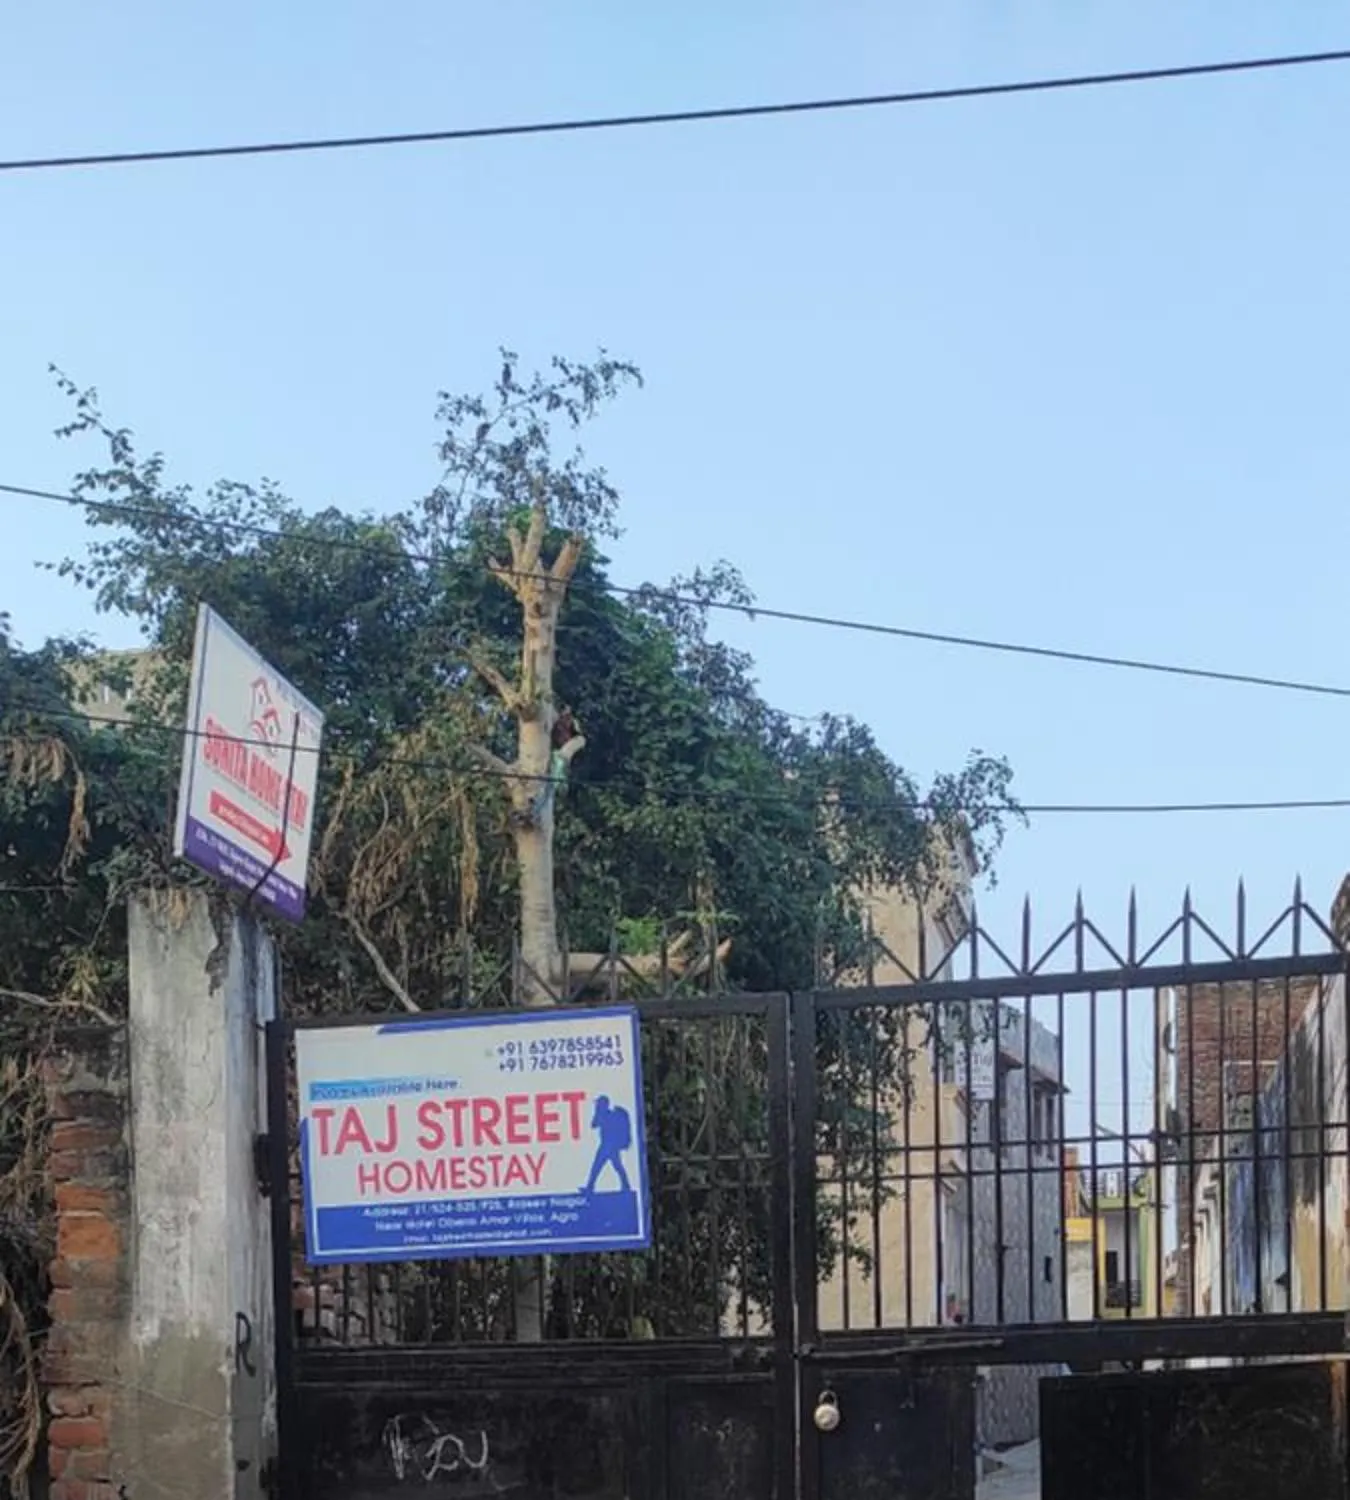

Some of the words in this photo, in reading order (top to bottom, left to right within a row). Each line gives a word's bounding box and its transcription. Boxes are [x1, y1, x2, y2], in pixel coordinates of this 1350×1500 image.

[497, 1040, 523, 1056] +91
[529, 1034, 622, 1054] 6397858541
[499, 1057, 525, 1072] +91
[530, 1052, 625, 1071] 7678219963
[311, 1103, 398, 1156] TAJ
[416, 1091, 587, 1151] STREET
[357, 1151, 548, 1195] HOMESTAY
